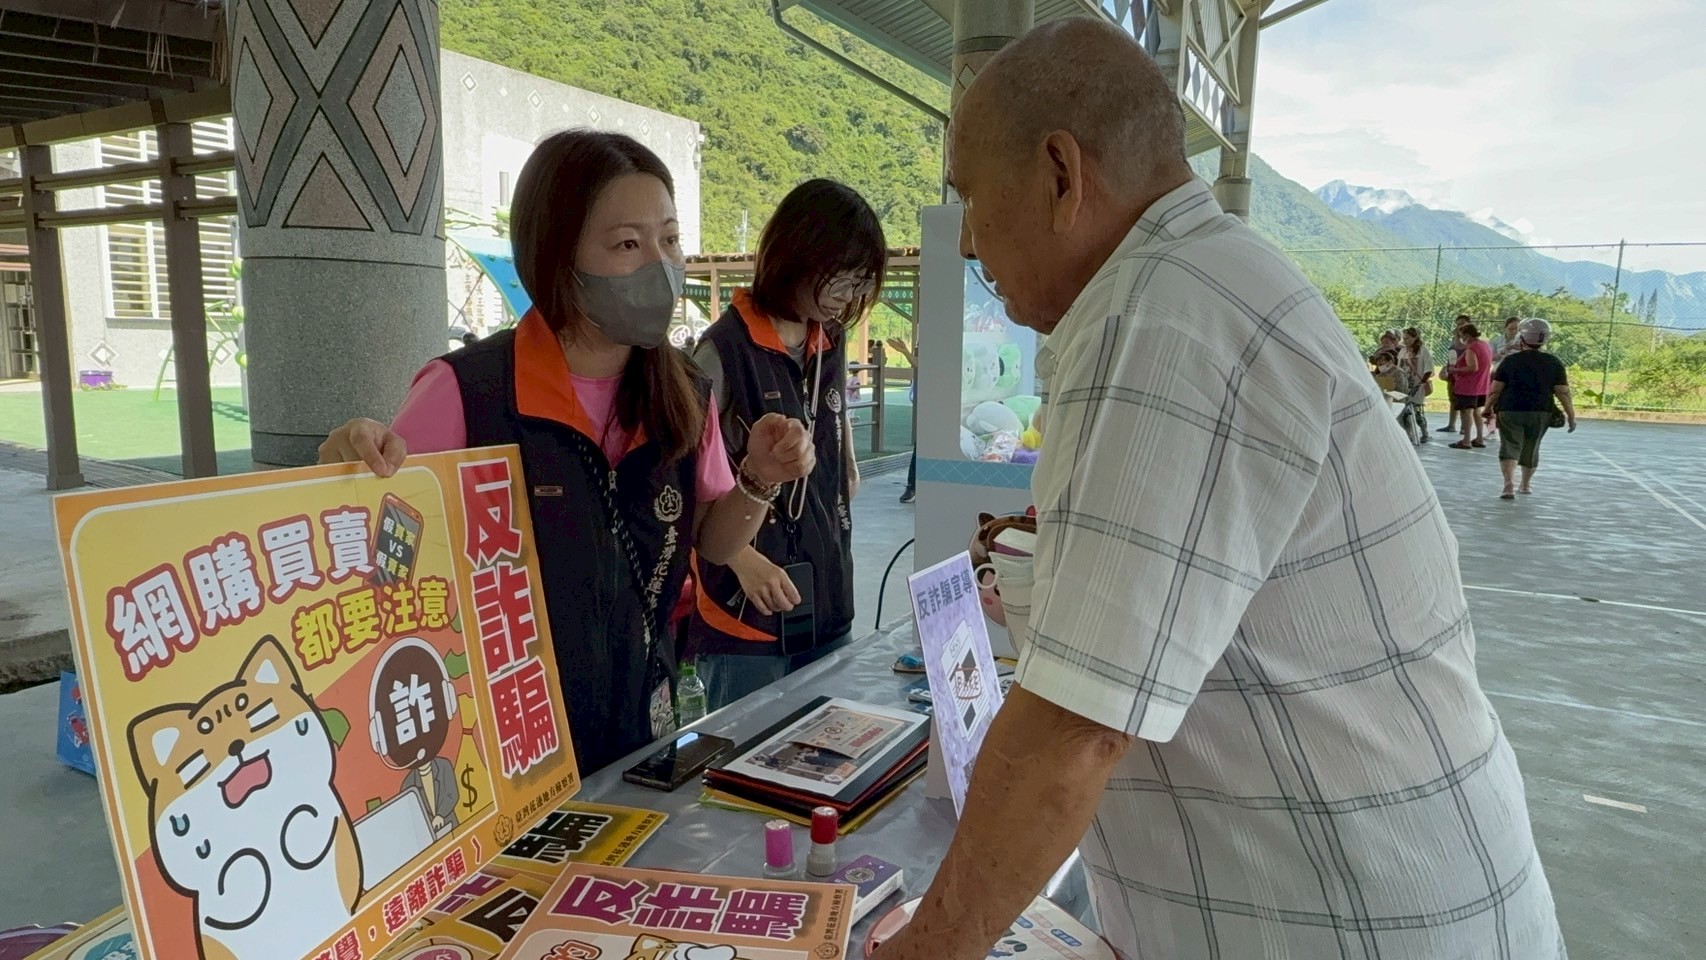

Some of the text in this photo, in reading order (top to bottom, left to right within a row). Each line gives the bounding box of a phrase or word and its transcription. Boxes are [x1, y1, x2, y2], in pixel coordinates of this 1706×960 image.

[389, 540, 404, 558] VS
[108, 503, 376, 680] 網購買賣
[293, 577, 451, 670] 都要注意
[457, 458, 559, 778] 反詐騙
[390, 679, 436, 744] 詐
[548, 875, 809, 941] 反詐騙
